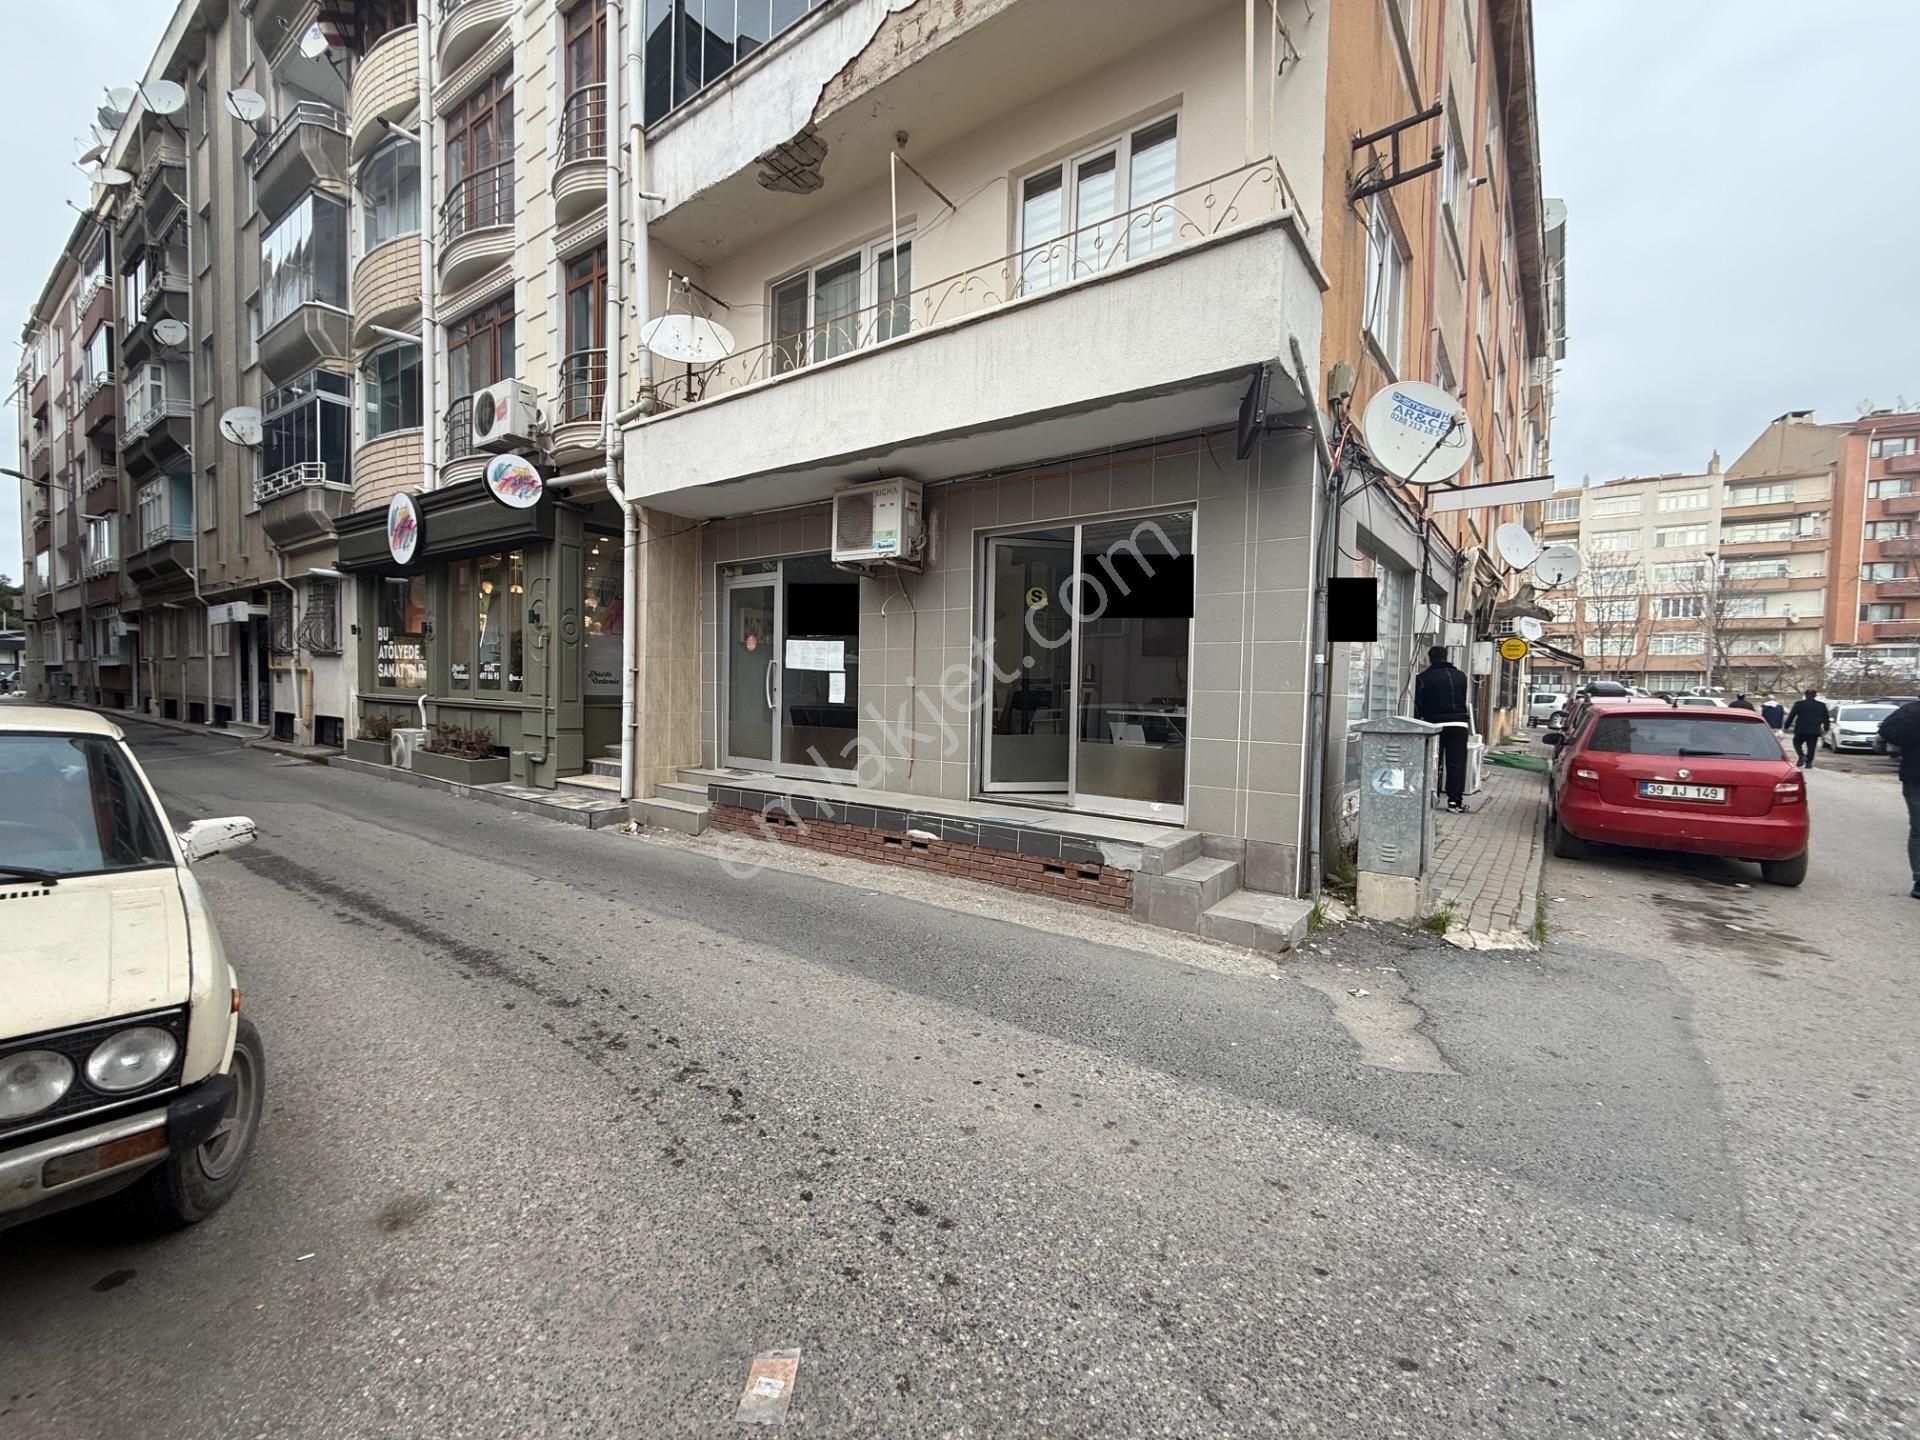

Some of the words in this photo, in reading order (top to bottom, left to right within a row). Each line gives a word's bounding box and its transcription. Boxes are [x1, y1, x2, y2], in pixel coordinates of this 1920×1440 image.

[1390, 412, 1408, 425] 0288
[1408, 420, 1423, 431] 212
[875, 487, 898, 497] SIGMA
[378, 627, 389, 641] BU
[378, 641, 420, 659] ATÖLYEDE
[378, 663, 404, 678] SANAT
[1649, 785, 1664, 795] 39
[1672, 786, 1687, 796] AJ
[1696, 787, 1718, 799] 149
